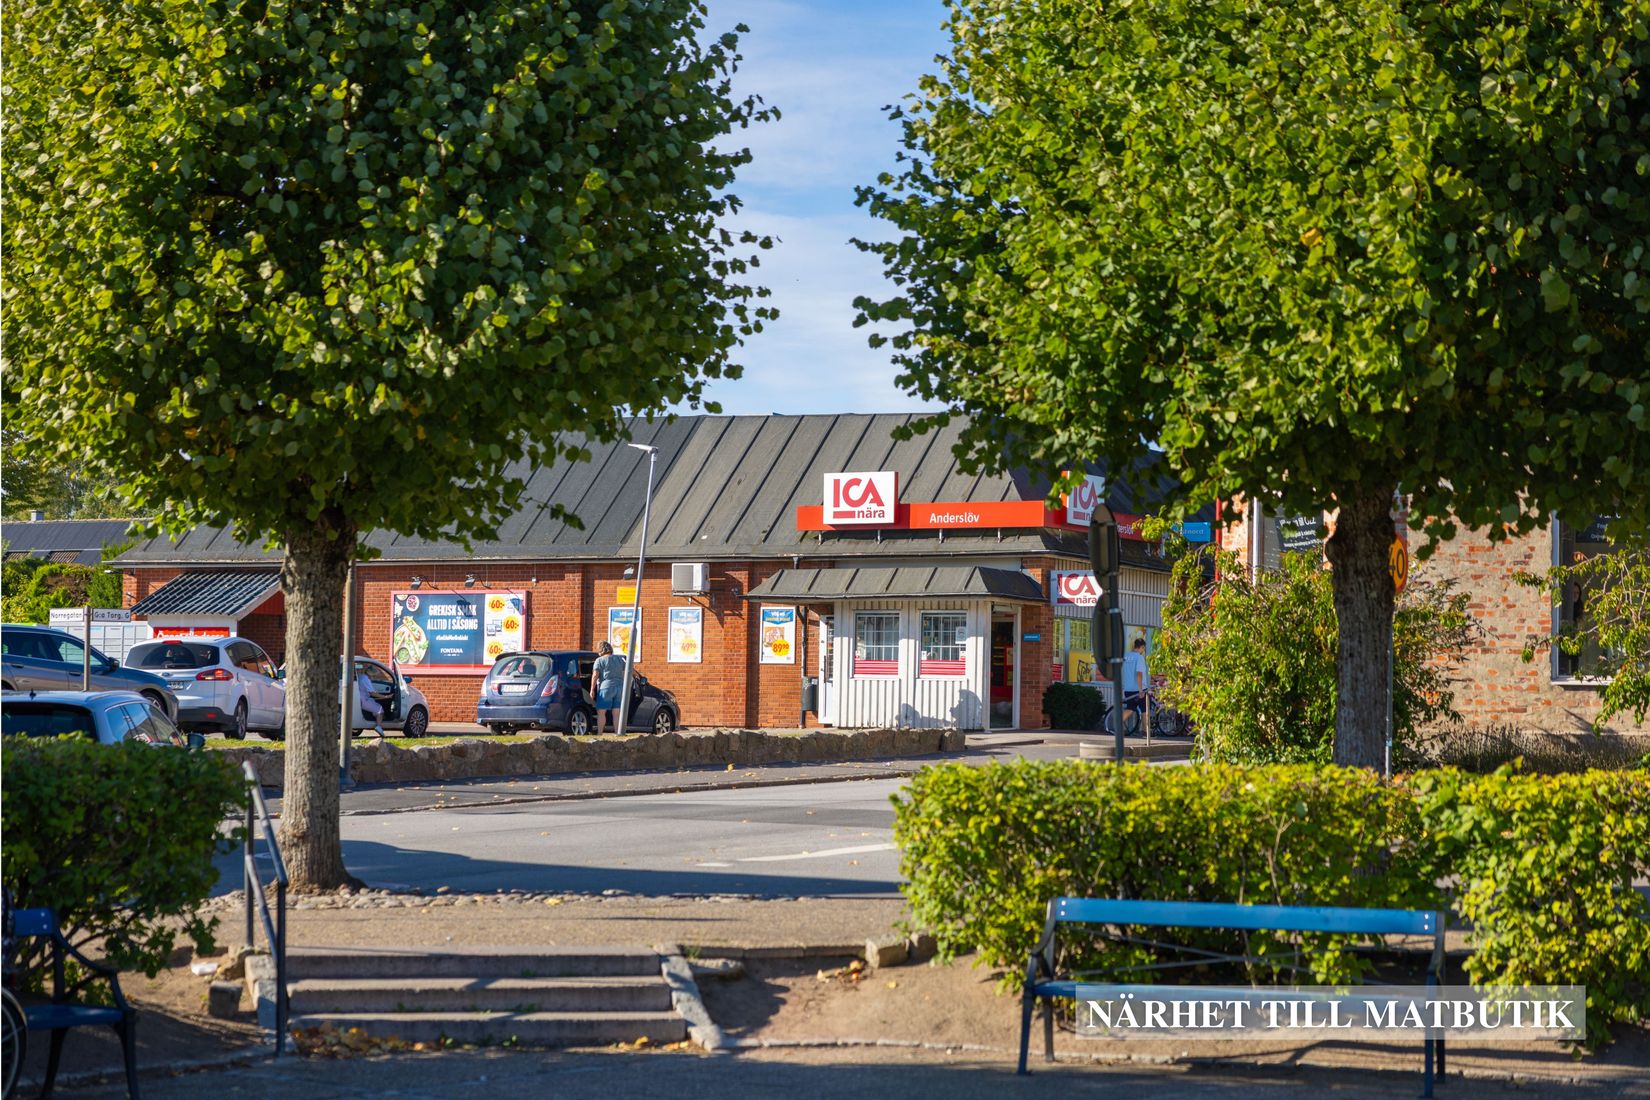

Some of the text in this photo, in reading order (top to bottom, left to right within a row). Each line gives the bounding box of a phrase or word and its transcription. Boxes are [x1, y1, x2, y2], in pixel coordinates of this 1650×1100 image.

[833, 478, 885, 508] ICA
[1073, 479, 1098, 510] ICA
[857, 508, 885, 519] nära
[929, 511, 980, 524] Anderslöv
[1056, 573, 1097, 596] ICA
[1076, 595, 1097, 604] nära
[428, 604, 456, 616] GREKISK
[427, 616, 478, 630] ALLTID I SÄSONG
